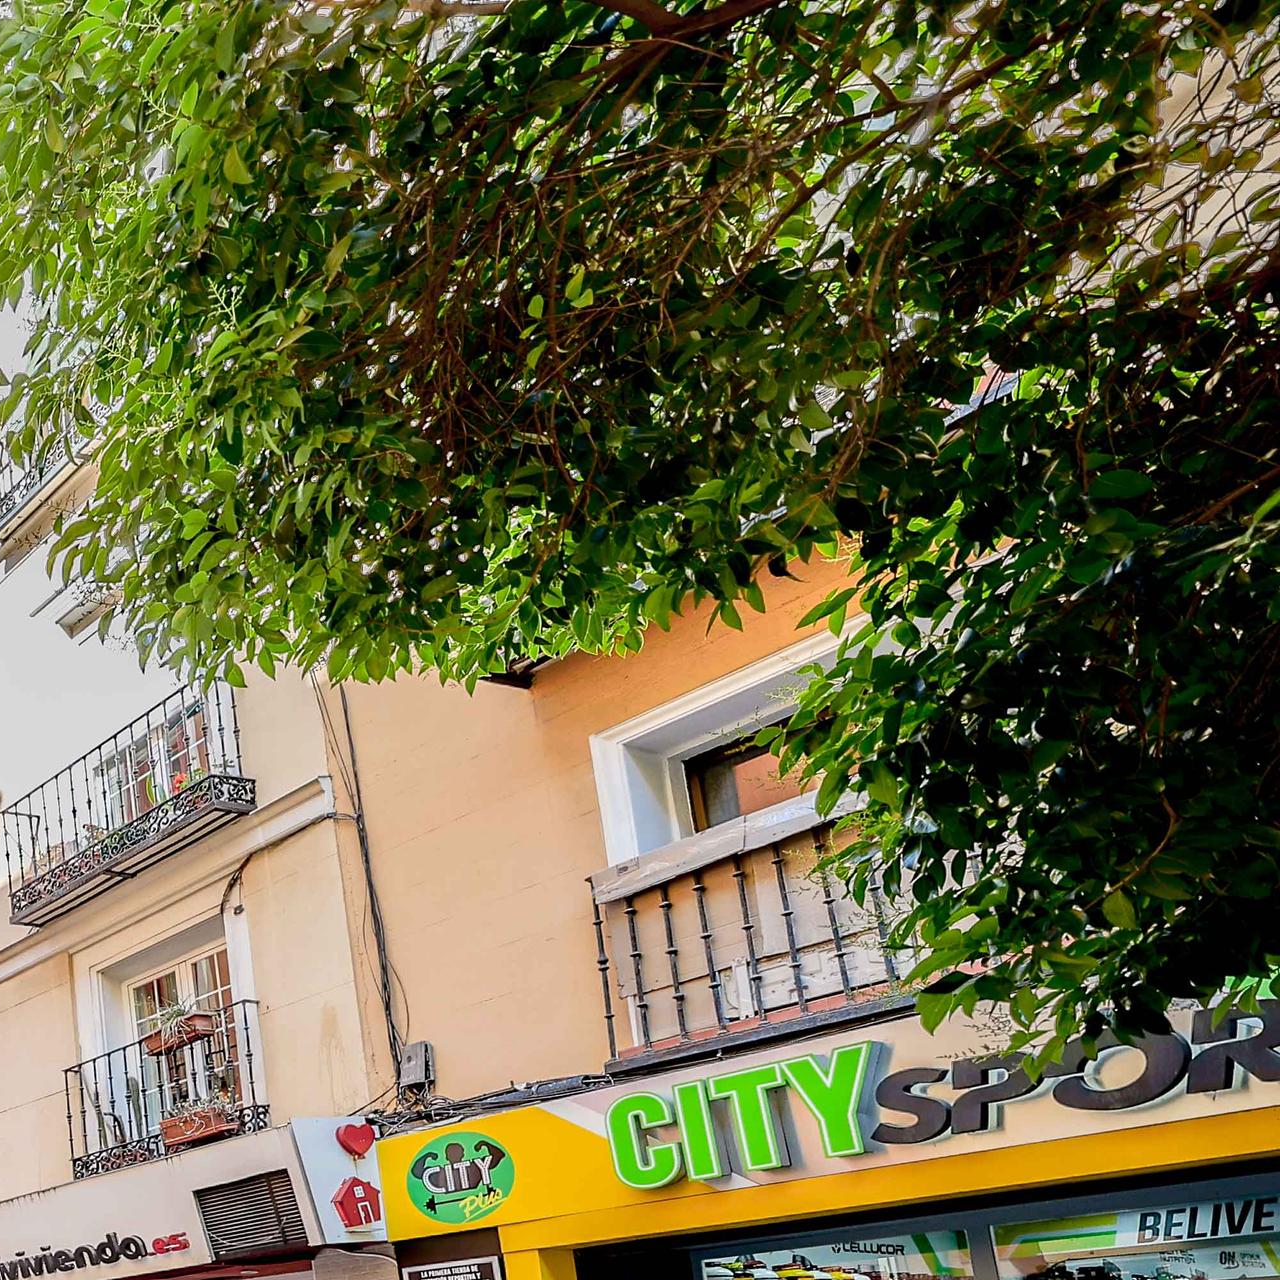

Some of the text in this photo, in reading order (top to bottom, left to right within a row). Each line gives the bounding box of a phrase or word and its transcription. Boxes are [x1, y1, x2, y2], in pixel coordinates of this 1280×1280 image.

[605, 1038, 875, 1191] CITY
[421, 1154, 494, 1195] CITY
[458, 1187, 503, 1218] Plus
